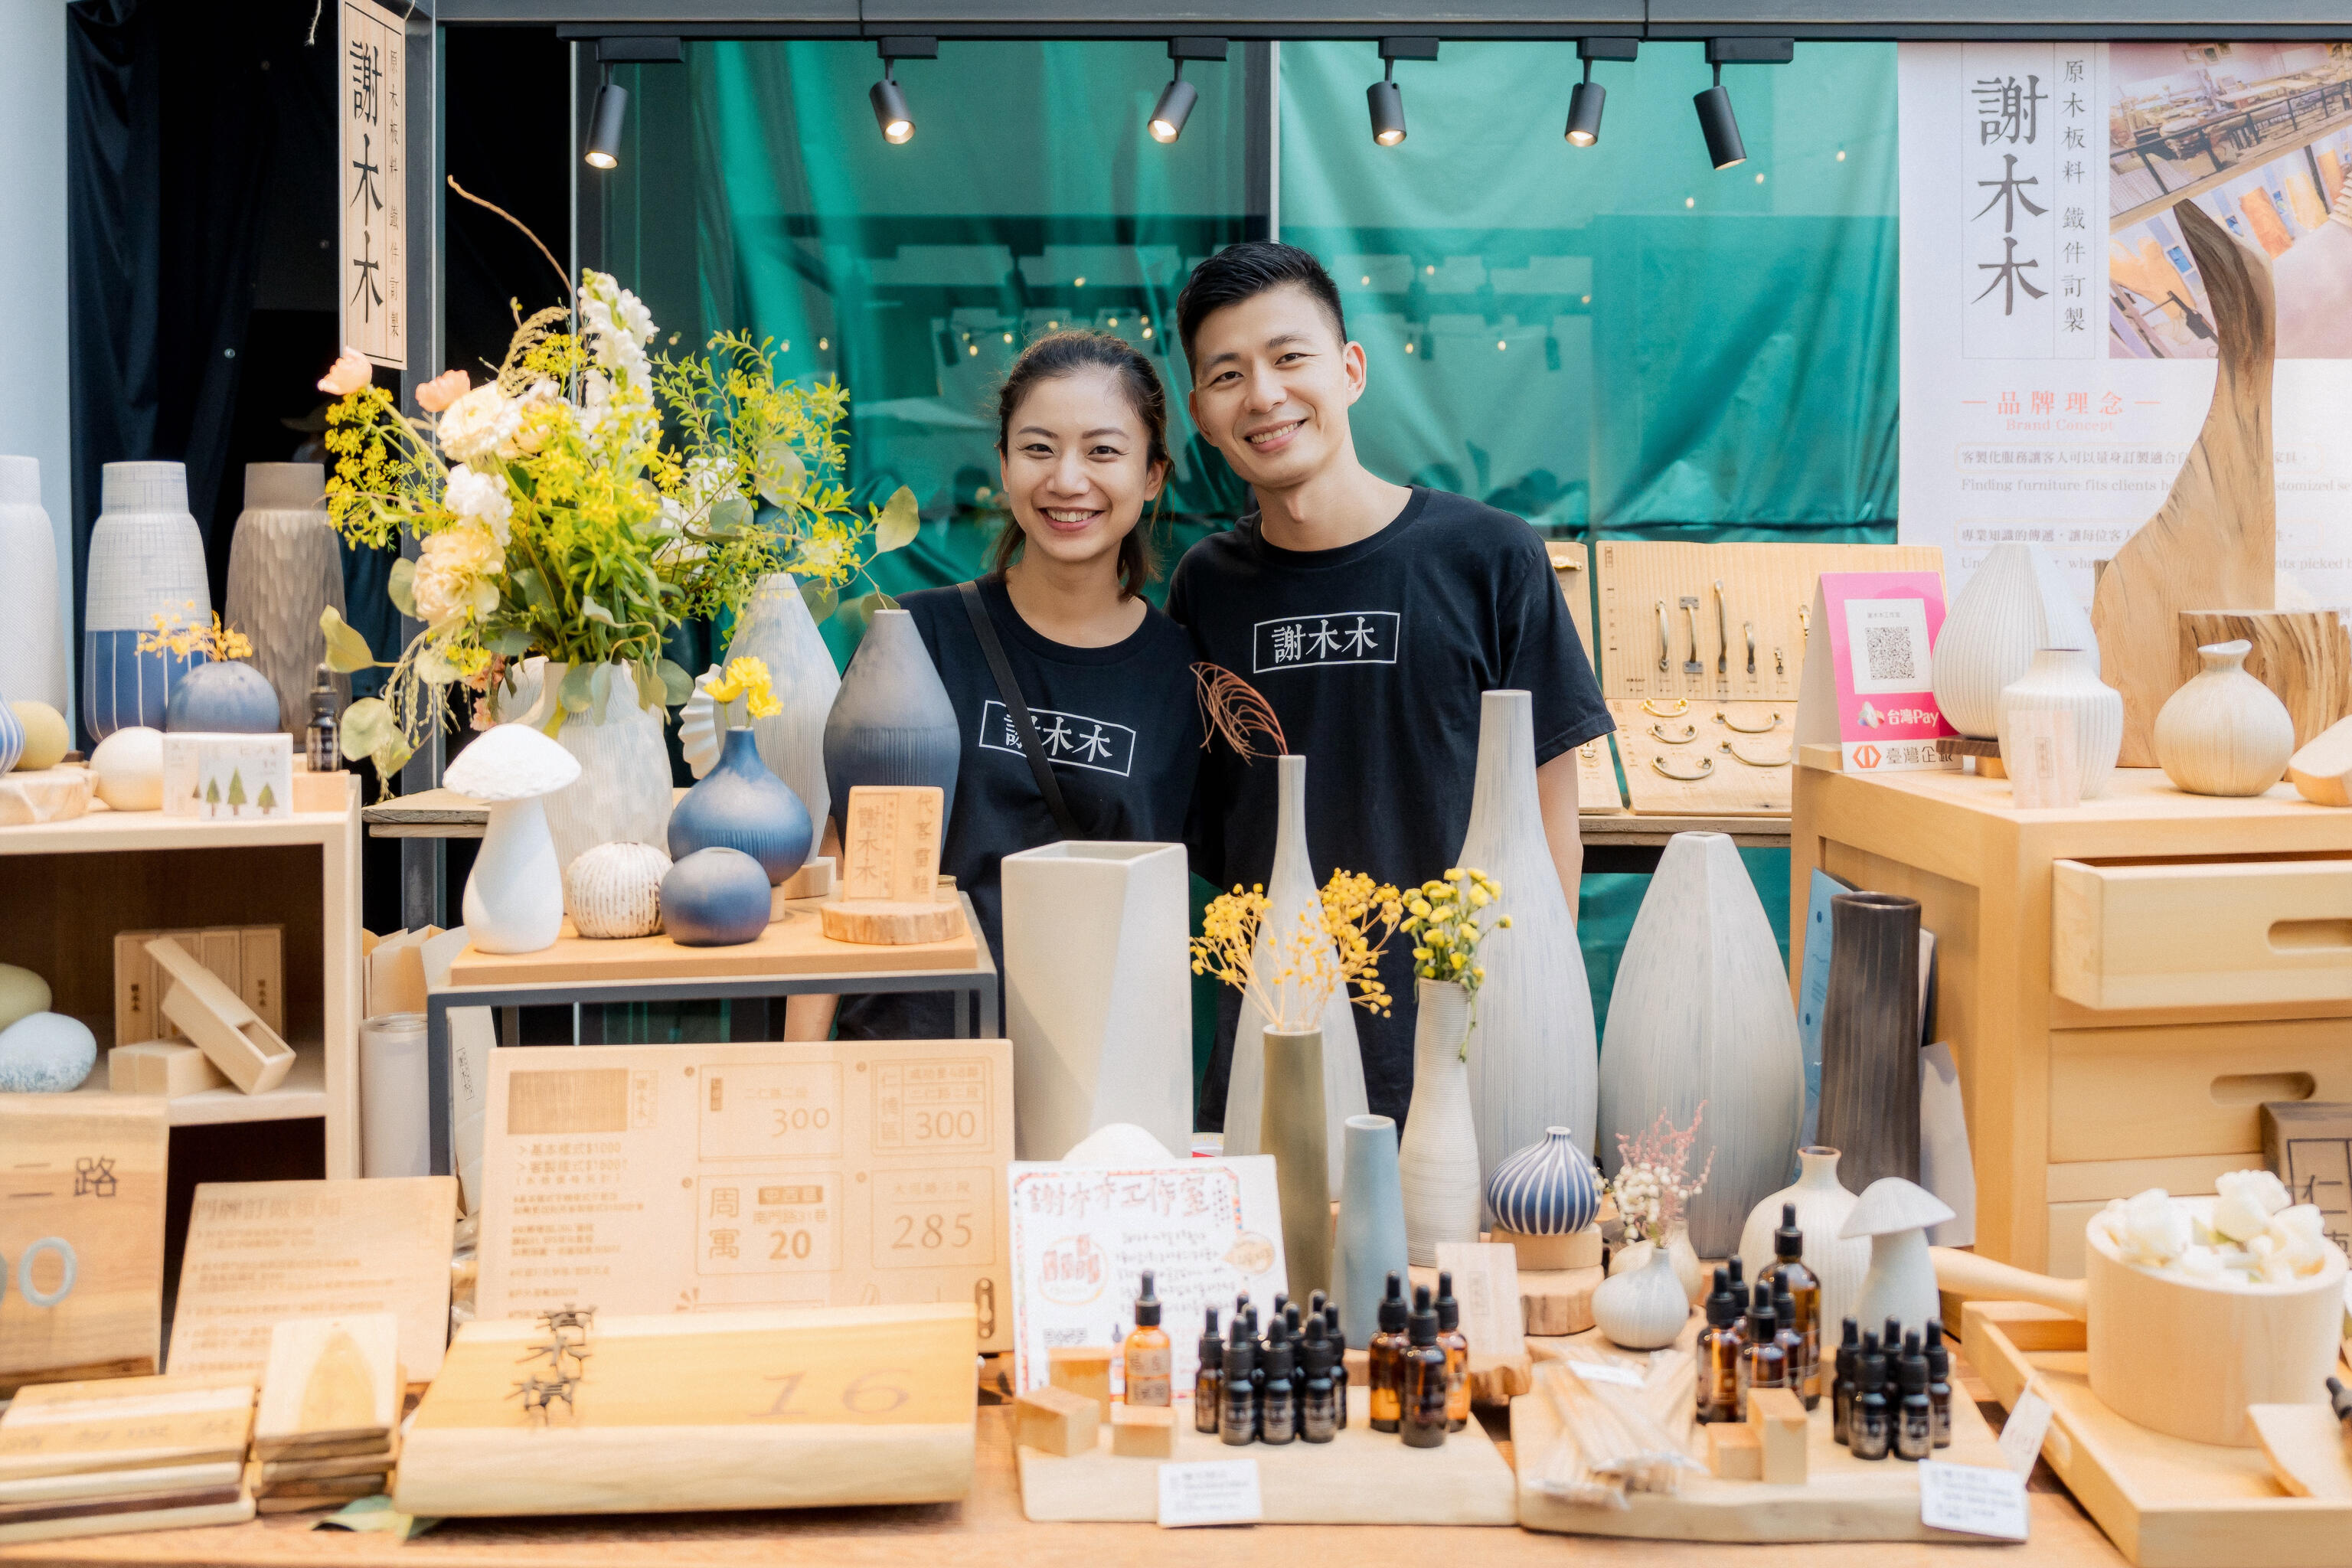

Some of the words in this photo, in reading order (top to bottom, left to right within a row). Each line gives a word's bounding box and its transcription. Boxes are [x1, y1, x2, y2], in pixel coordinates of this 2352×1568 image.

[2061, 60, 2086, 185] 原木板料
[349, 40, 384, 324] 謝木木
[1971, 74, 2050, 316] 謝木木
[2061, 206, 2086, 333] 鐵件訂製
[1998, 390, 2124, 415] 品牌理念
[2006, 419, 2050, 431] Brand
[2056, 419, 2114, 433] Concept
[1962, 479, 2012, 492] Finding
[2017, 478, 2080, 492] furniture
[2086, 478, 2107, 492] fits
[2112, 478, 2157, 492] clients
[2275, 479, 2334, 491] stomized
[1271, 616, 1378, 664] 謝木木
[1887, 708, 1939, 728] 台灣Pay
[772, 1107, 830, 1138] 300
[915, 1109, 977, 1140] 300
[709, 1187, 740, 1259] 周寓
[890, 1213, 973, 1250] 285
[769, 1229, 812, 1260] 20
[748, 1367, 912, 1419] 16
